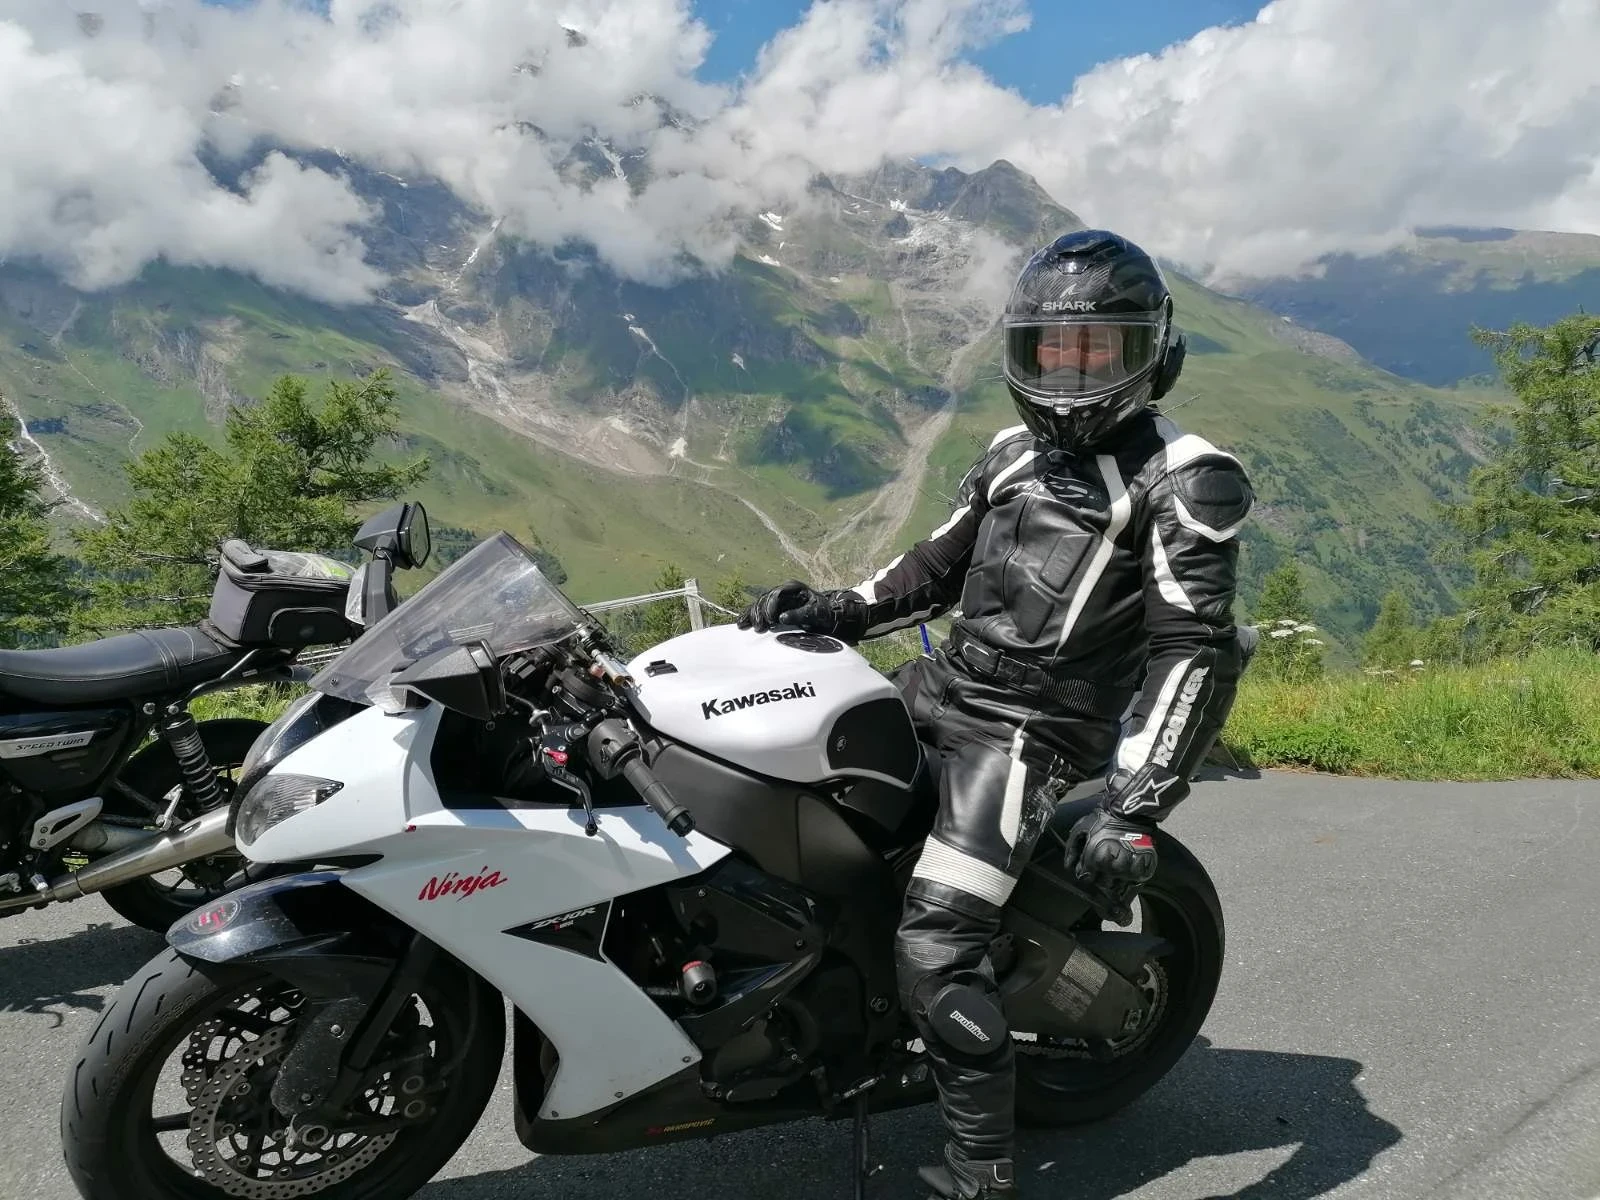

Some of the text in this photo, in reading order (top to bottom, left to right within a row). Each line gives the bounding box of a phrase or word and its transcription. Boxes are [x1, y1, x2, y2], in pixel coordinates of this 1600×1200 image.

[1042, 300, 1097, 312] SHARK
[701, 682, 816, 720] Kawasaki
[1155, 667, 1209, 768] ROBIKER
[417, 866, 508, 903] Ninja
[950, 1011, 990, 1042] probiker
